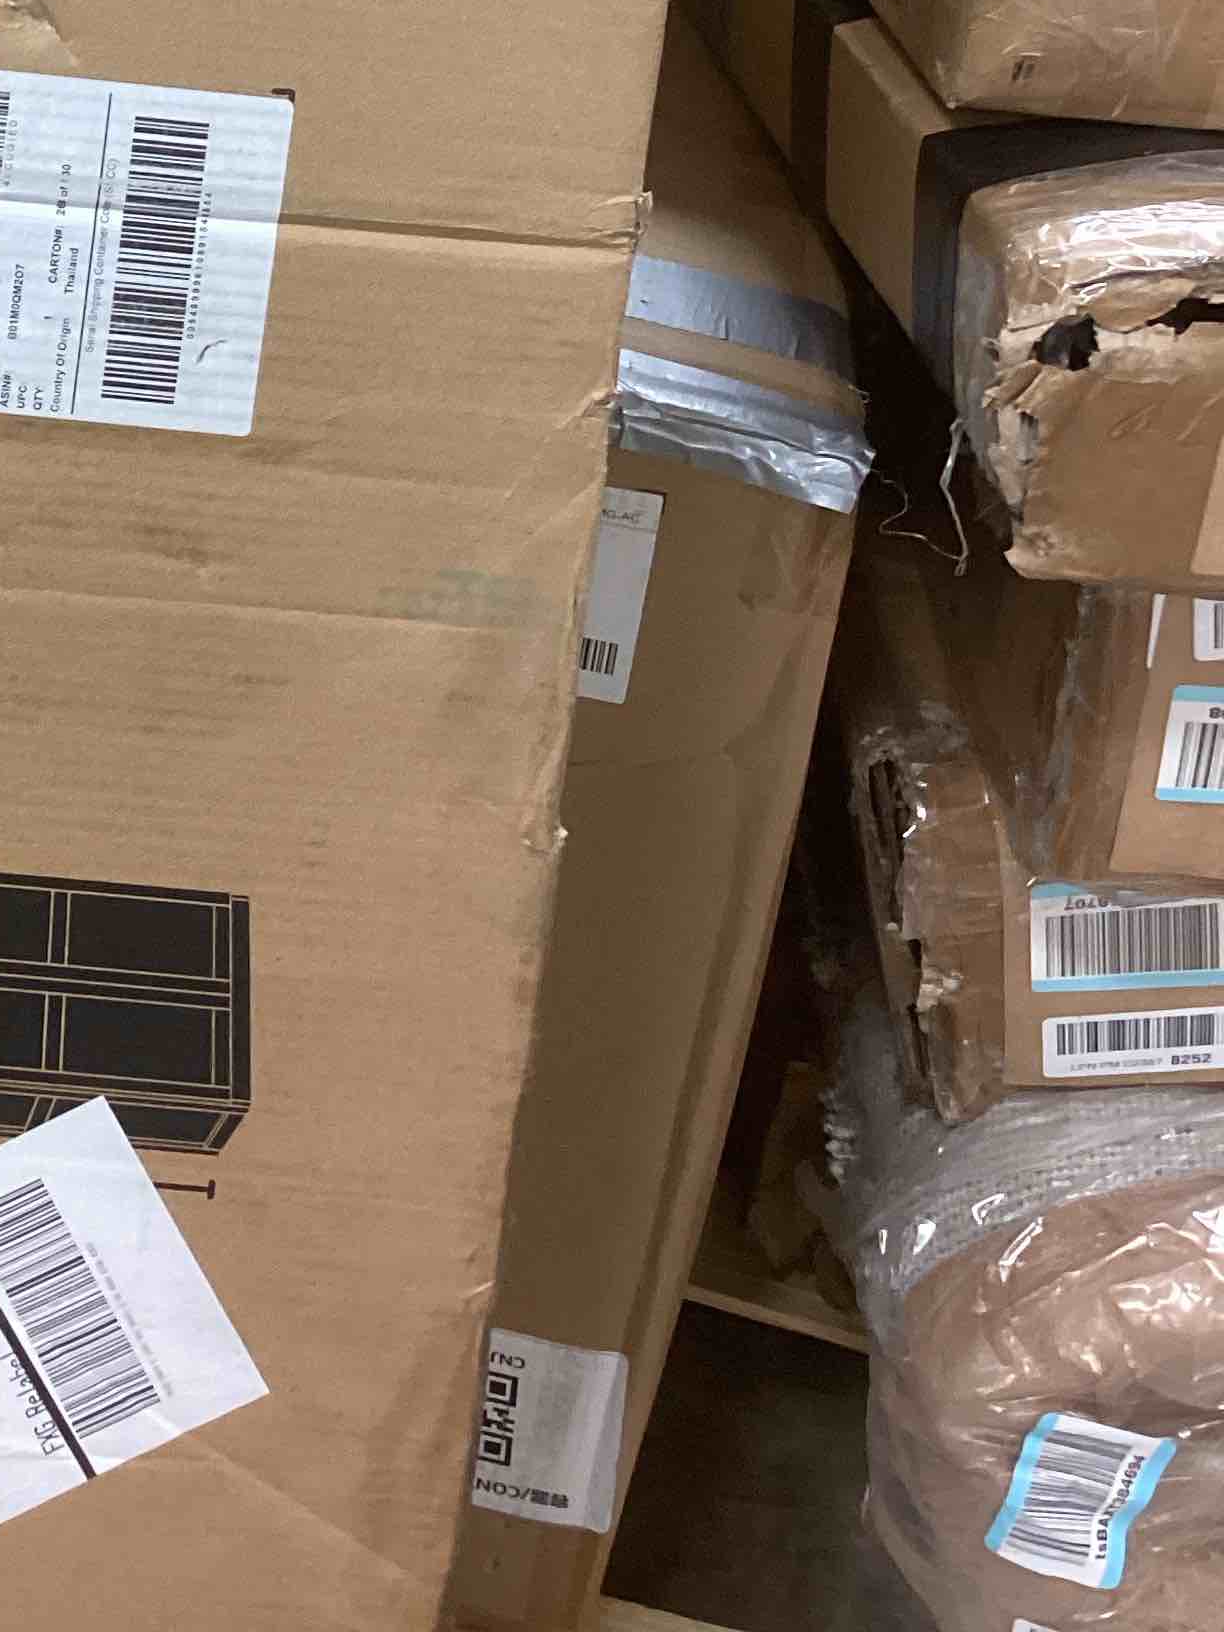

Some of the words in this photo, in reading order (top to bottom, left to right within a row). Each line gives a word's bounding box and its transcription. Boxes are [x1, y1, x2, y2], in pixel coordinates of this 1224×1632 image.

[64, 247, 79, 294] Thailand
[57, 317, 71, 351] Origin
[55, 353, 64, 366] Of
[50, 370, 65, 412] Country
[34, 1420, 65, 1456] FXG
